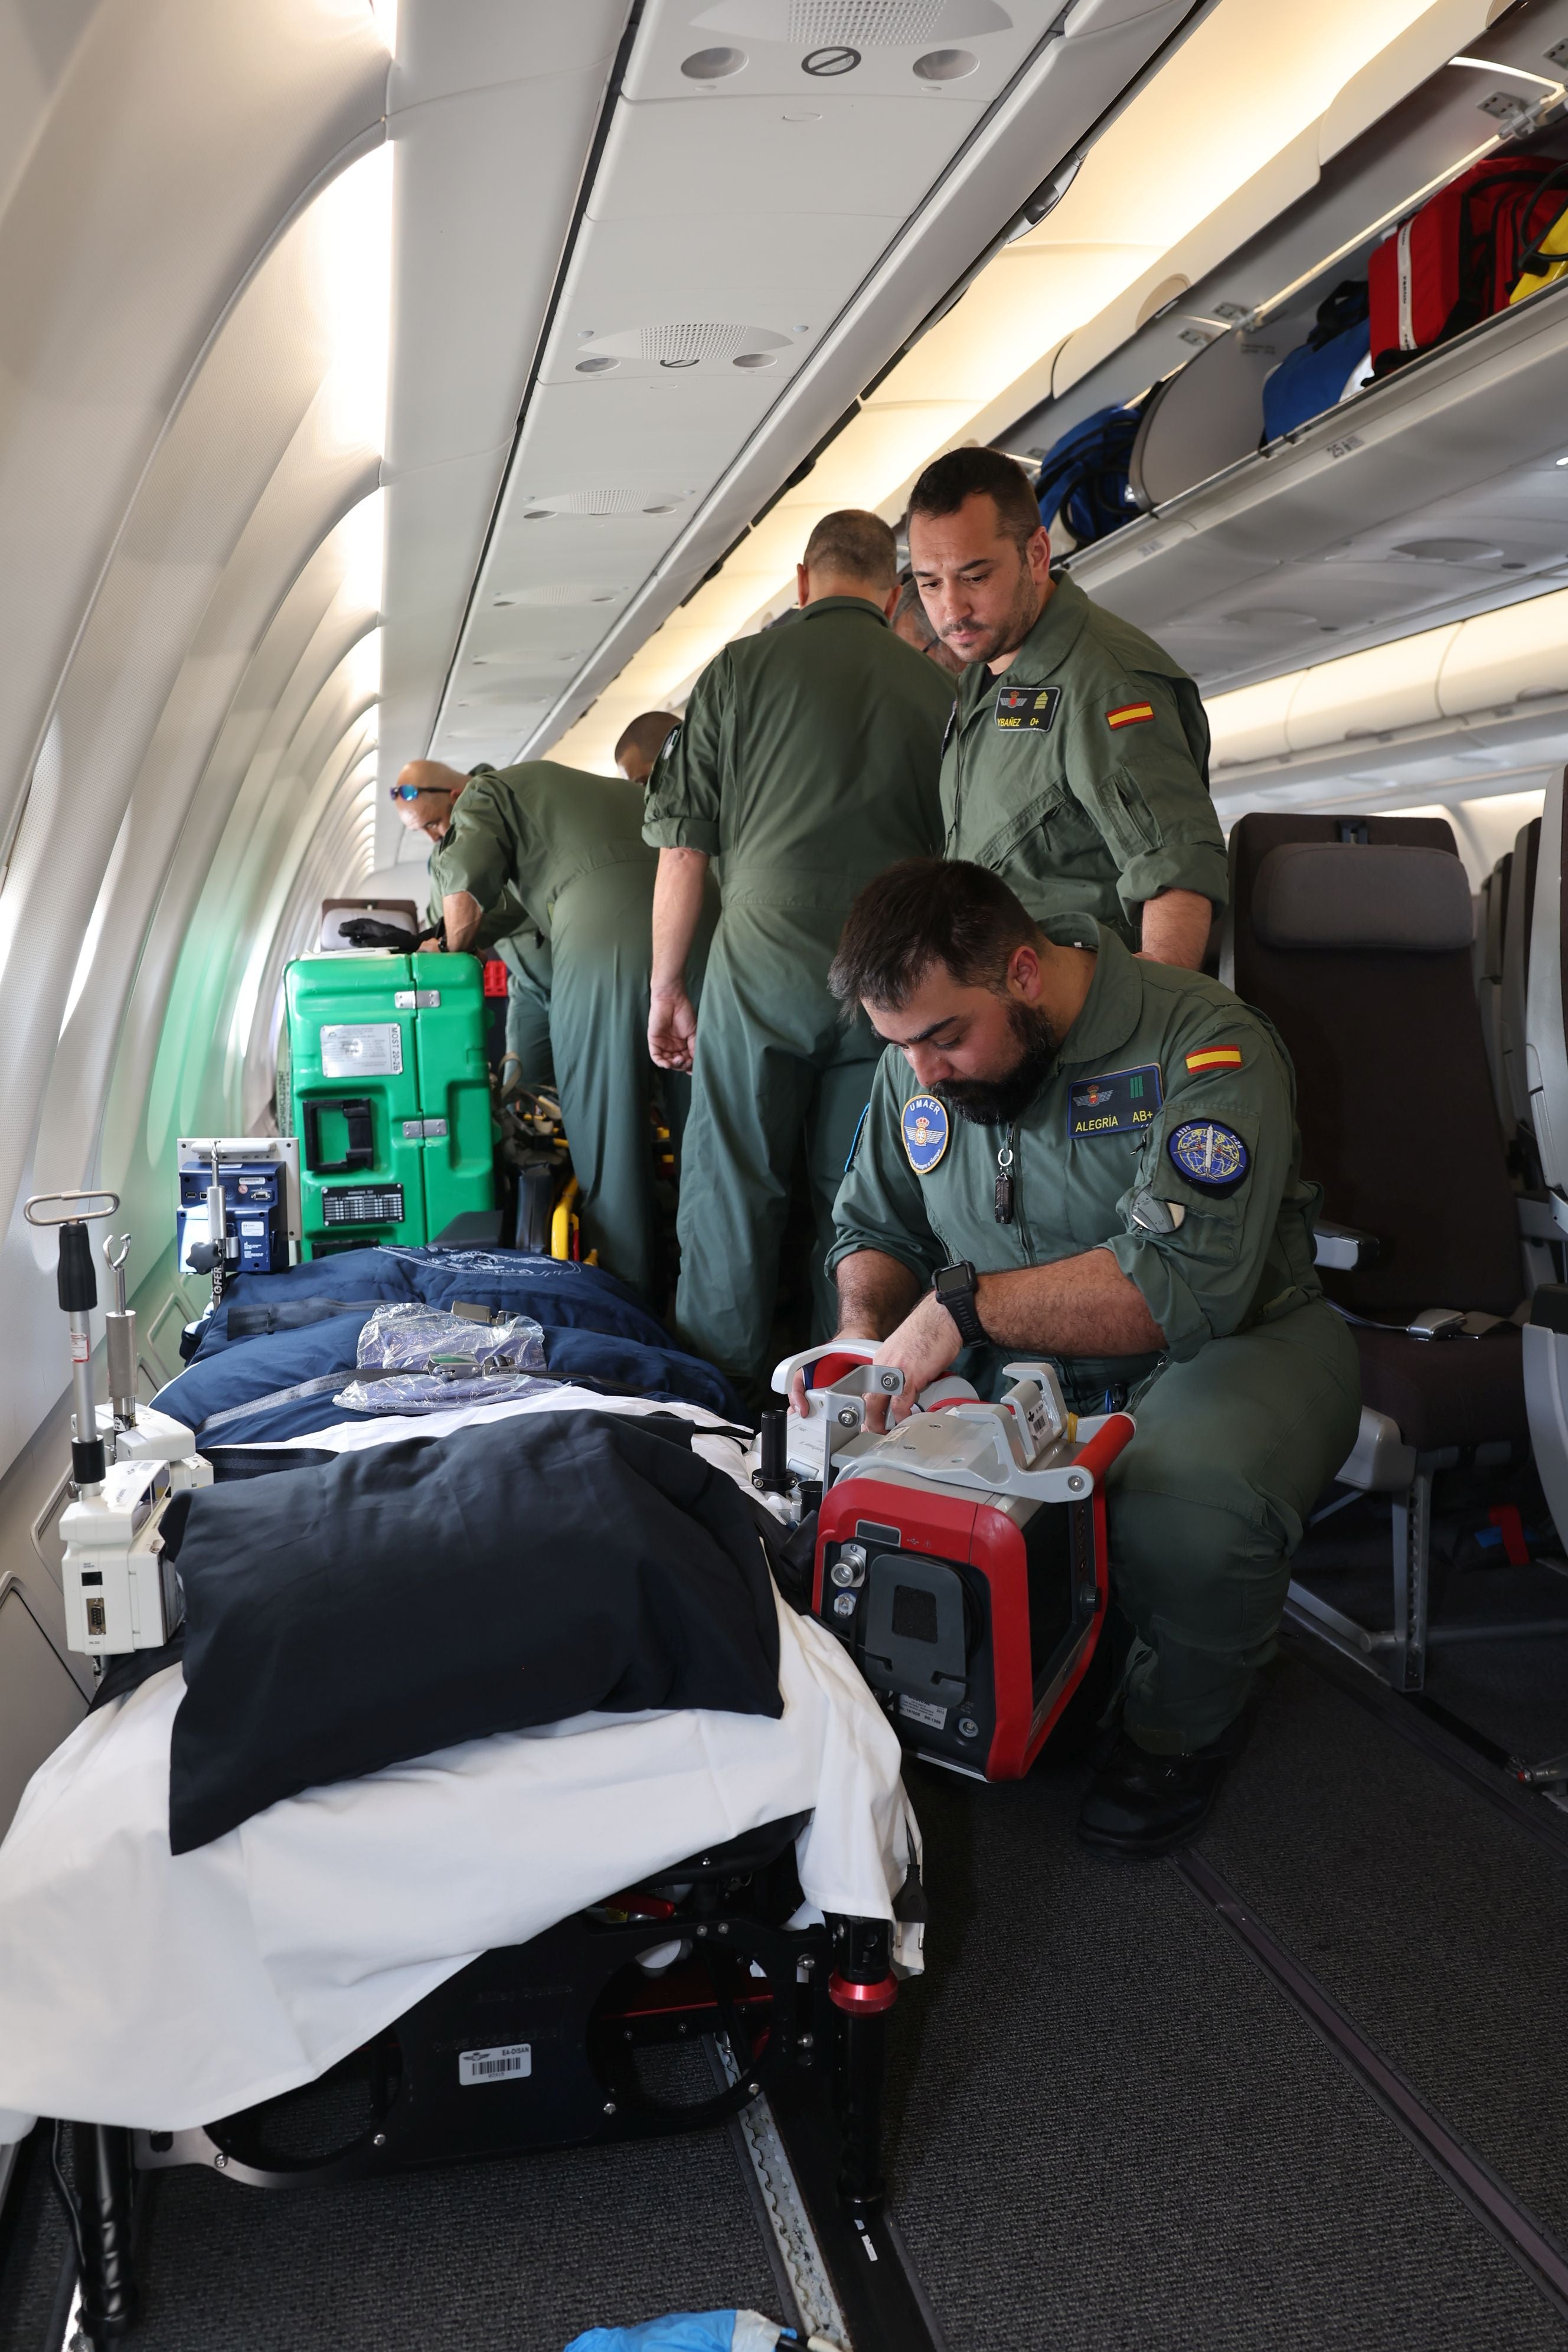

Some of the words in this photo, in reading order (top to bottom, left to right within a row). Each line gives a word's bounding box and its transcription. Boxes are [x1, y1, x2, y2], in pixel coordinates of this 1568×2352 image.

[997, 716, 1021, 727] YBAÑEZ
[391, 1027, 400, 1048] MOST
[910, 1099, 940, 1115] UMAER
[1075, 1114, 1118, 1132] ALEGRÍA
[1132, 1110, 1153, 1123] AB+
[502, 2047, 530, 2056] EA-DISAN
